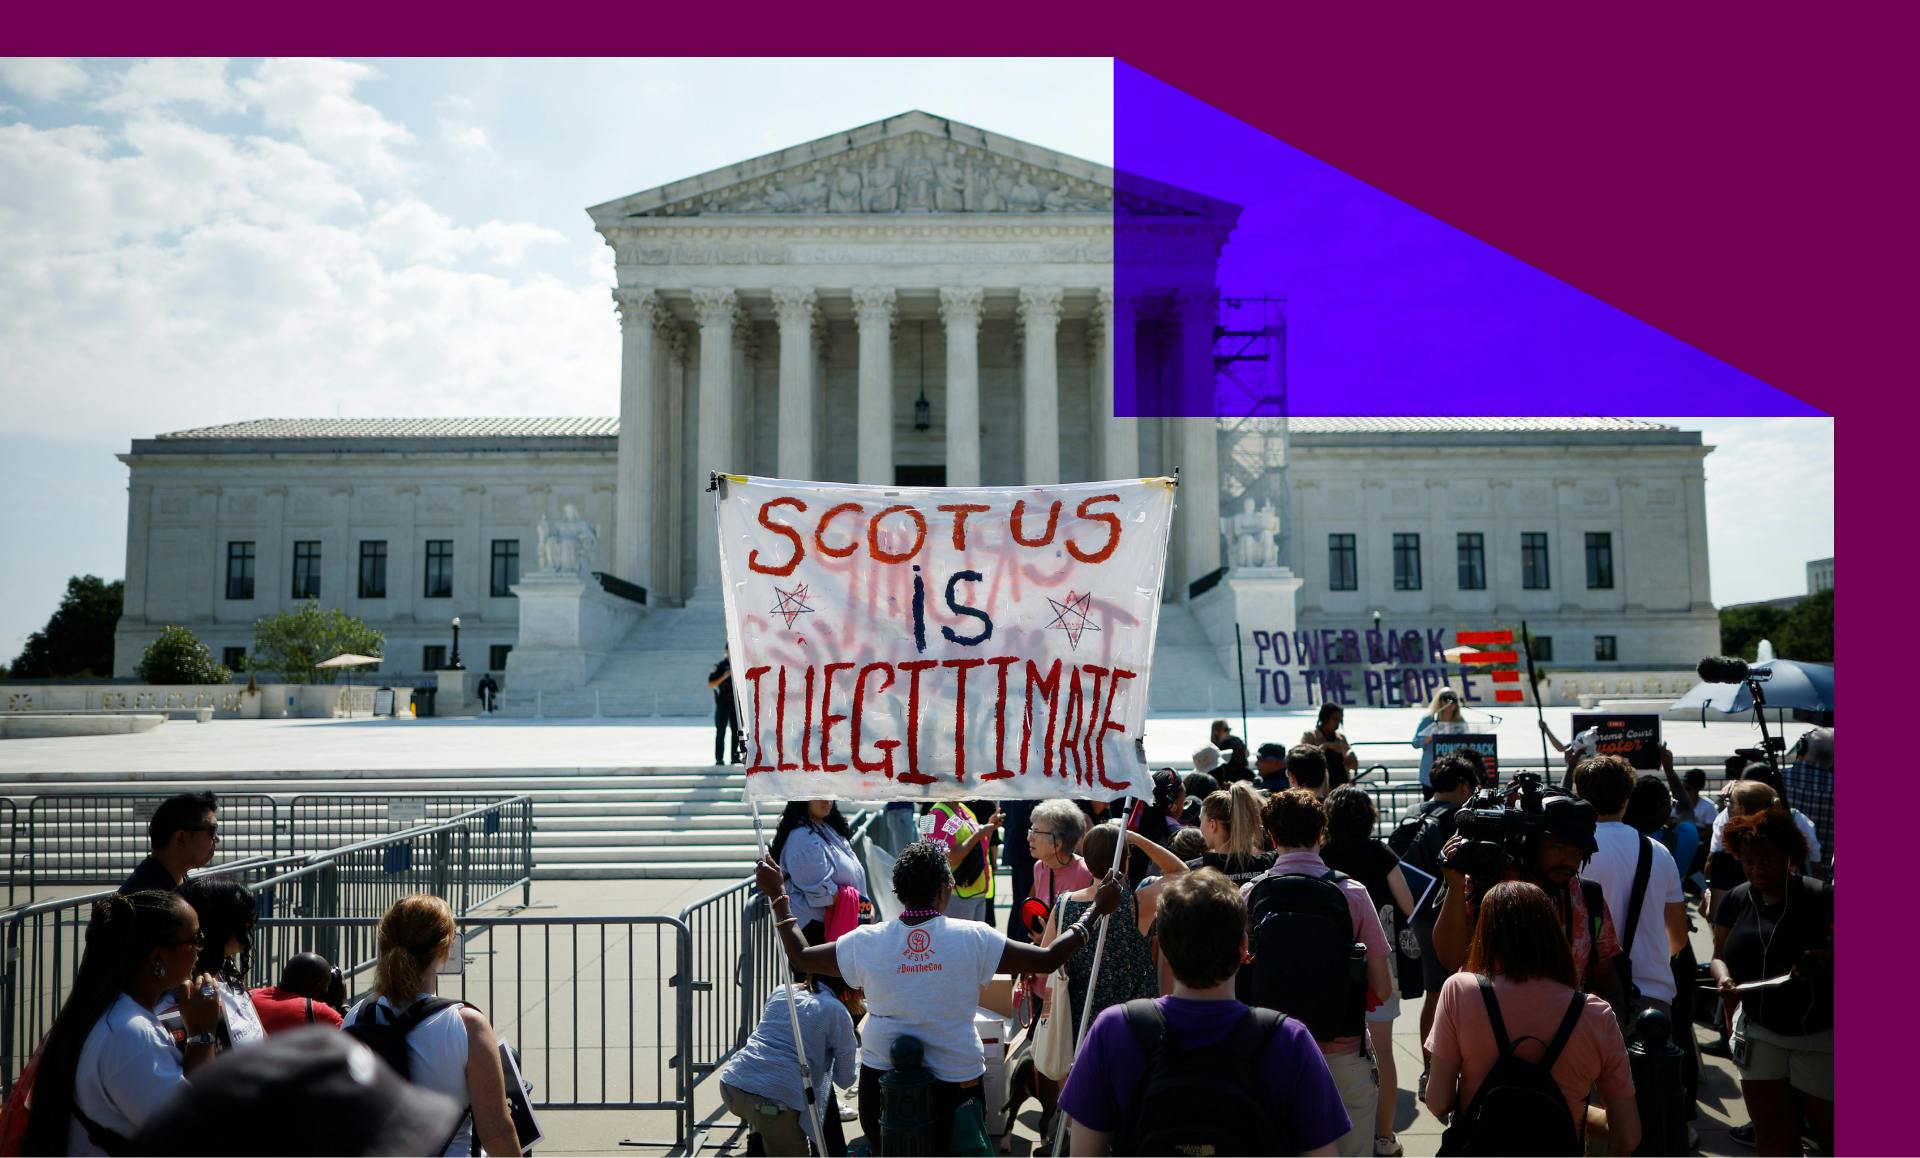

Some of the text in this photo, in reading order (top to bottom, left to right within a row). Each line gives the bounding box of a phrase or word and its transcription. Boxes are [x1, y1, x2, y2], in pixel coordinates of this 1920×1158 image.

[748, 494, 1121, 577] SCOTUS
[1252, 627, 1447, 666] POWER BACK
[1255, 668, 1291, 705] TO
[1299, 668, 1356, 705] THE
[745, 655, 1137, 791] ILLEGITIMATE
[1626, 729, 1654, 738] Court
[902, 948, 936, 962] RESIST
